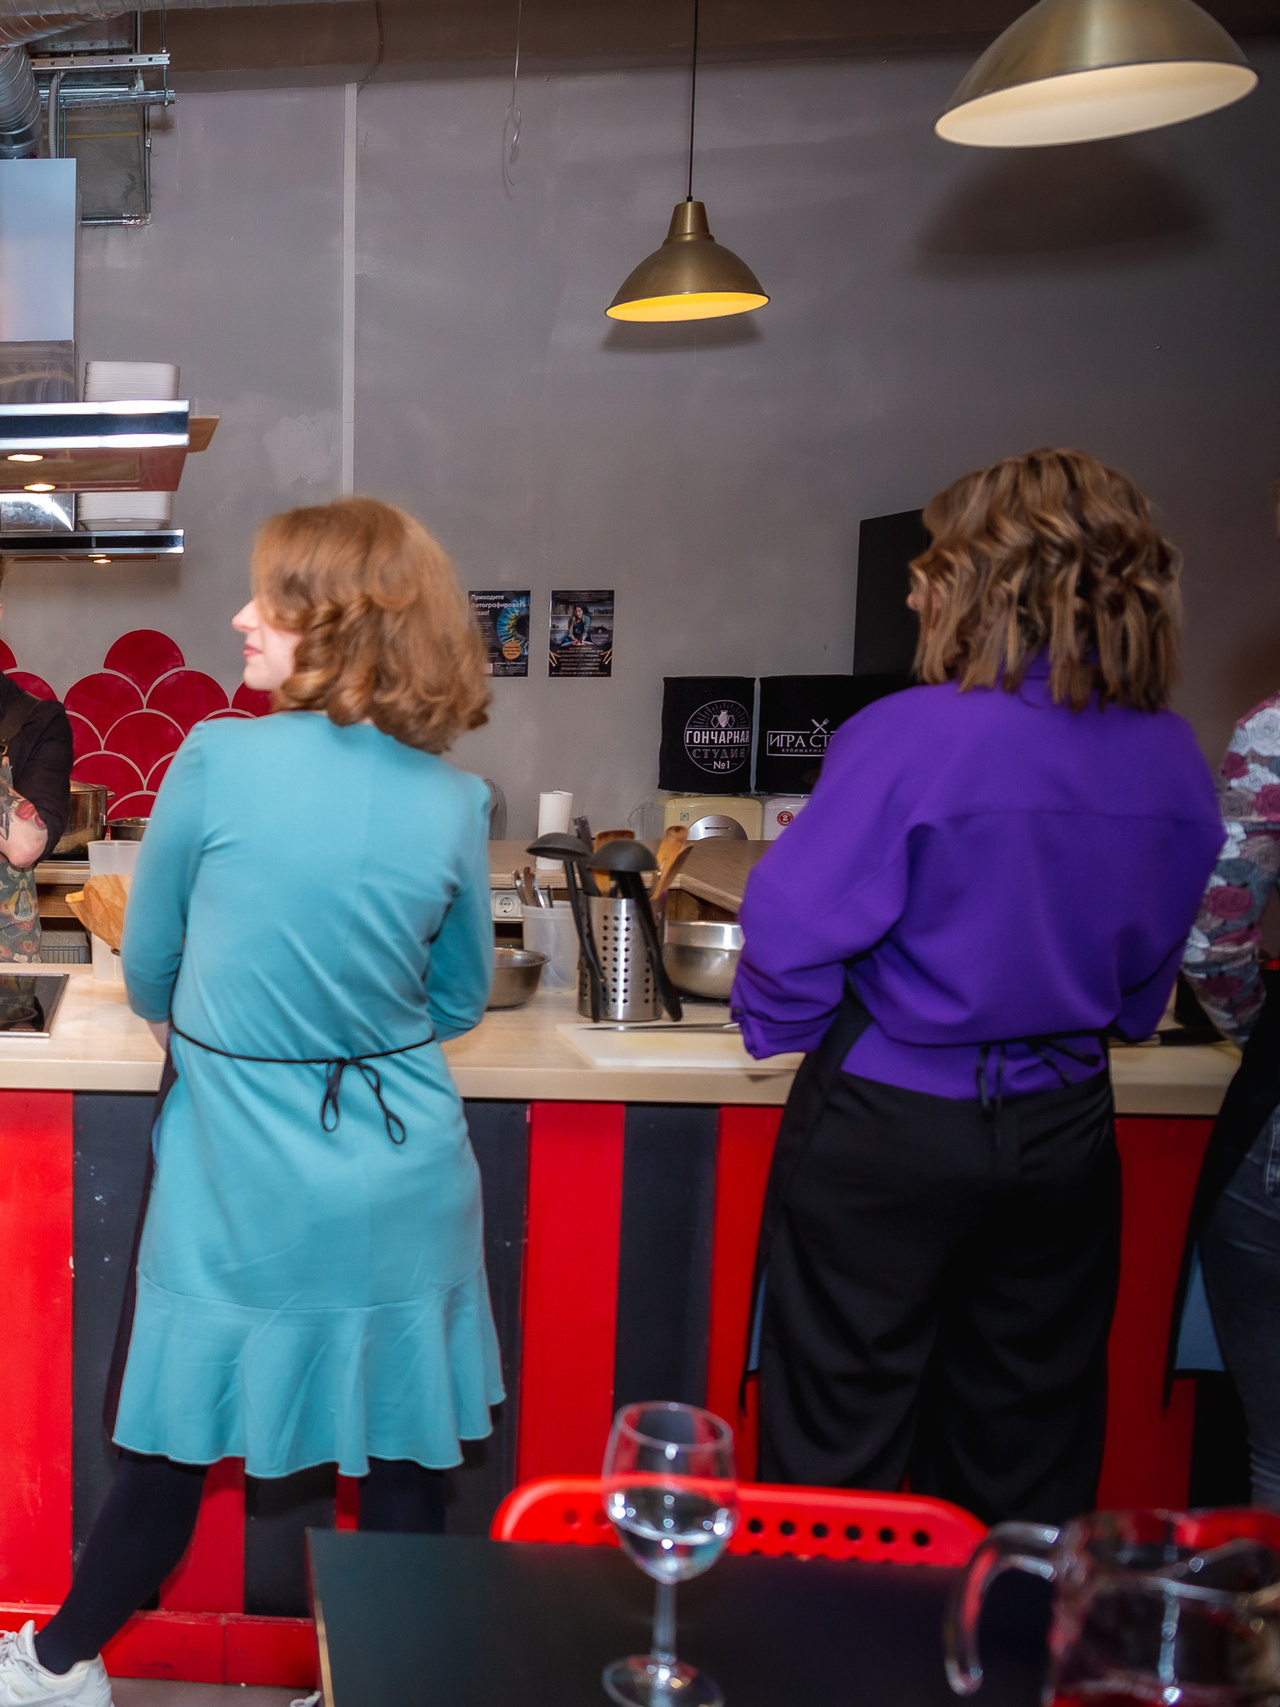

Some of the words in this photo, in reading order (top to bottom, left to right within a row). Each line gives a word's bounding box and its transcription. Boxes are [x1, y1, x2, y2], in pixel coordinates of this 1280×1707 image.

[686, 730, 749, 744] ГОНЧАРНАЯ
[770, 734, 806, 748] ИГРА
[809, 734, 834, 748] СТ
[692, 748, 746, 760] СТУДИЯ
[713, 760, 730, 770] №1
